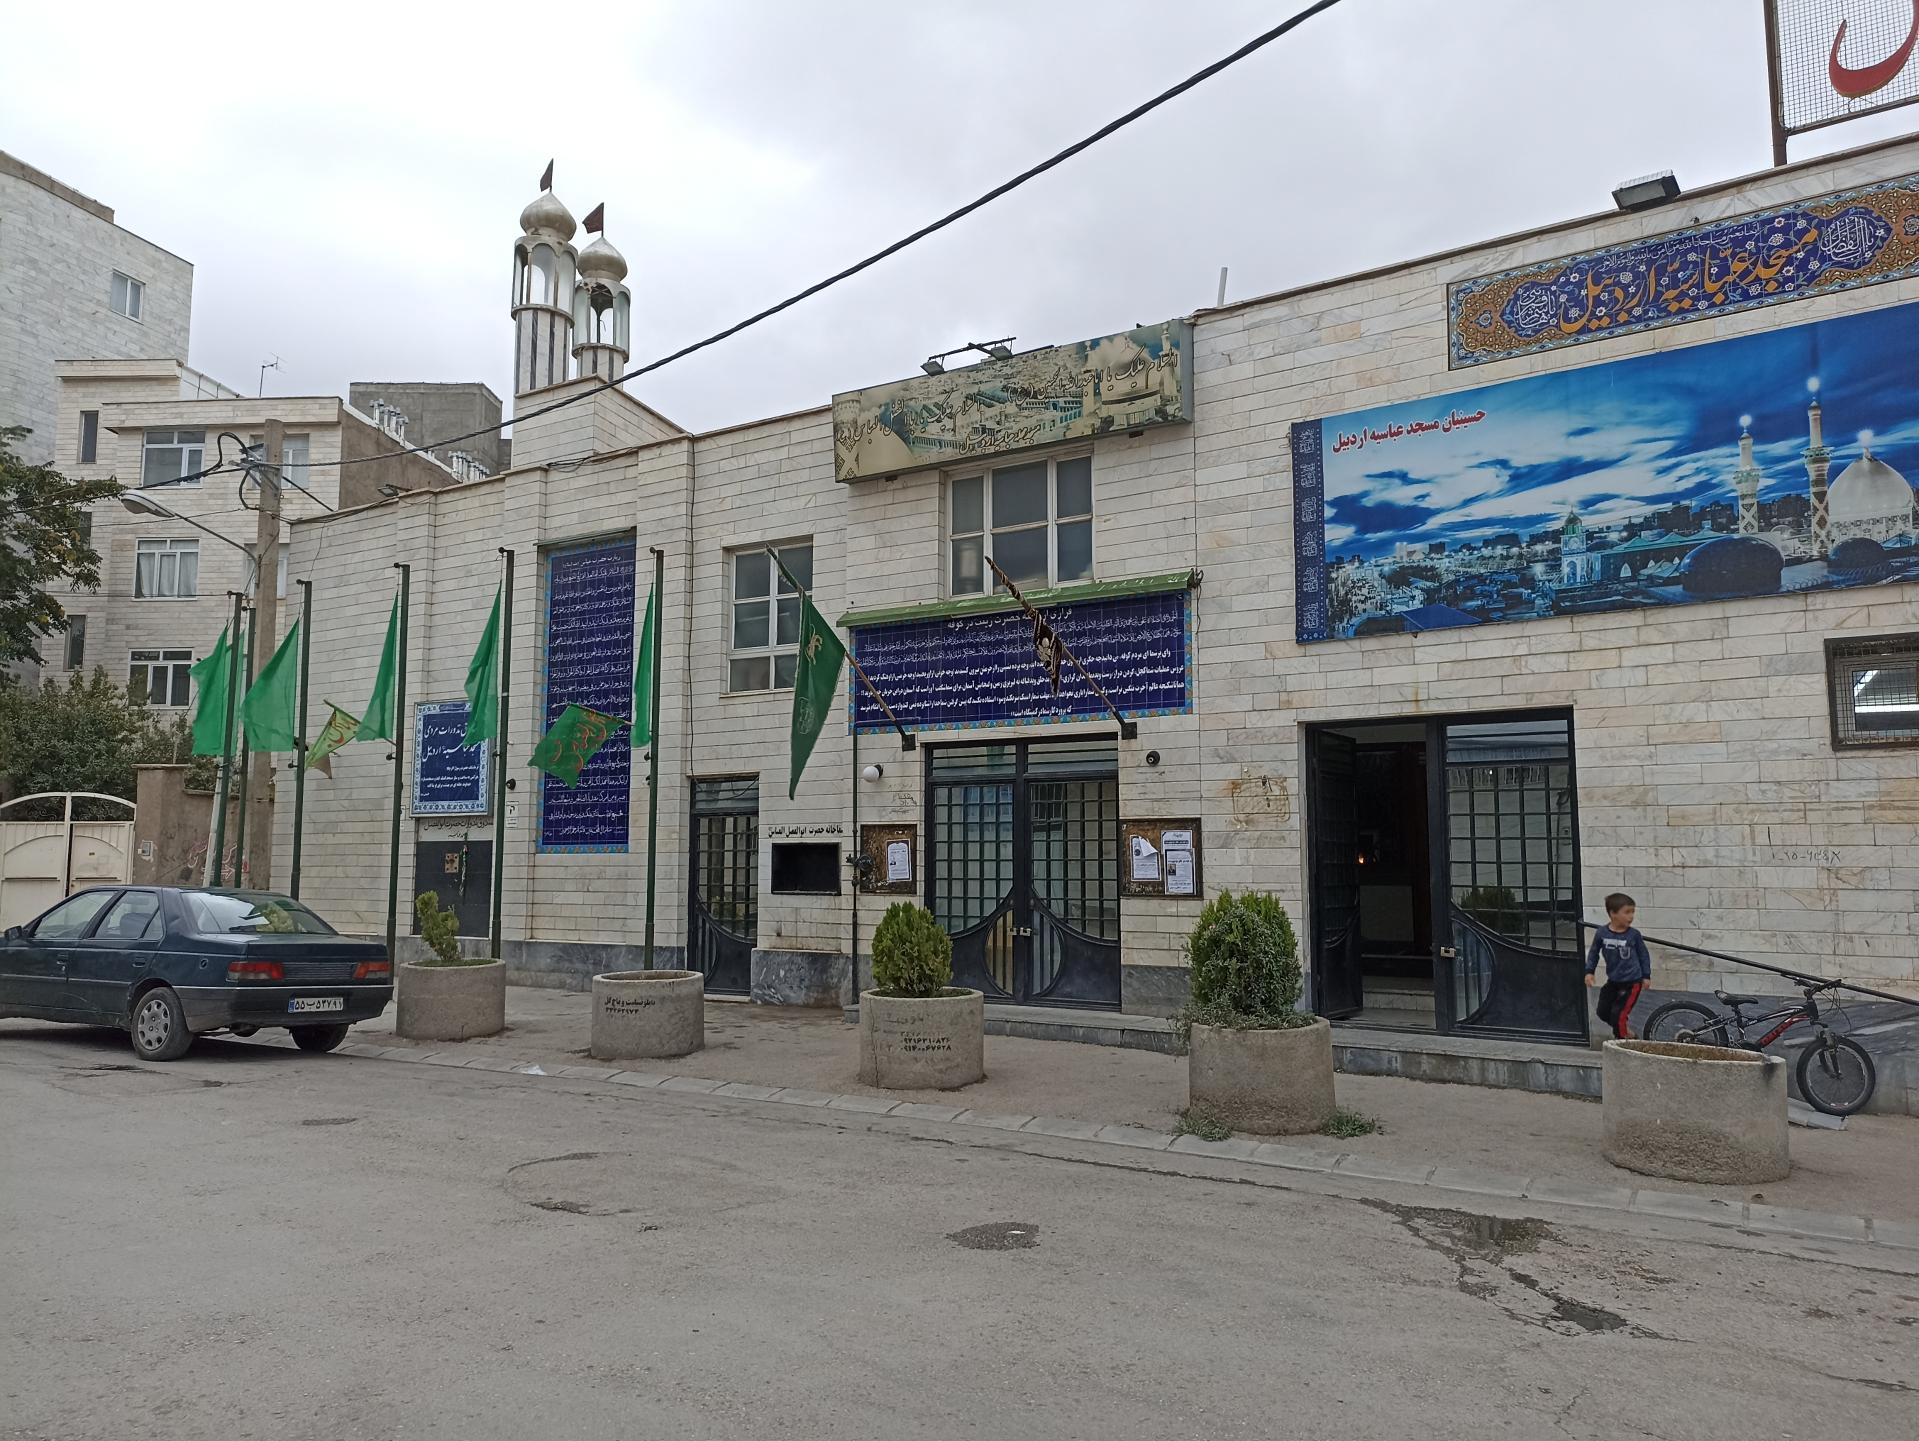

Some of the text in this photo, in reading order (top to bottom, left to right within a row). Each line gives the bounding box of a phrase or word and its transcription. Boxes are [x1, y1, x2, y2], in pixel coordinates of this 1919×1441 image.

[1406, 419, 1440, 437] مسجد
[1442, 409, 1486, 433] حسینیان
[1332, 427, 1367, 453] اردبیل
[1370, 422, 1404, 444] عباسیه
